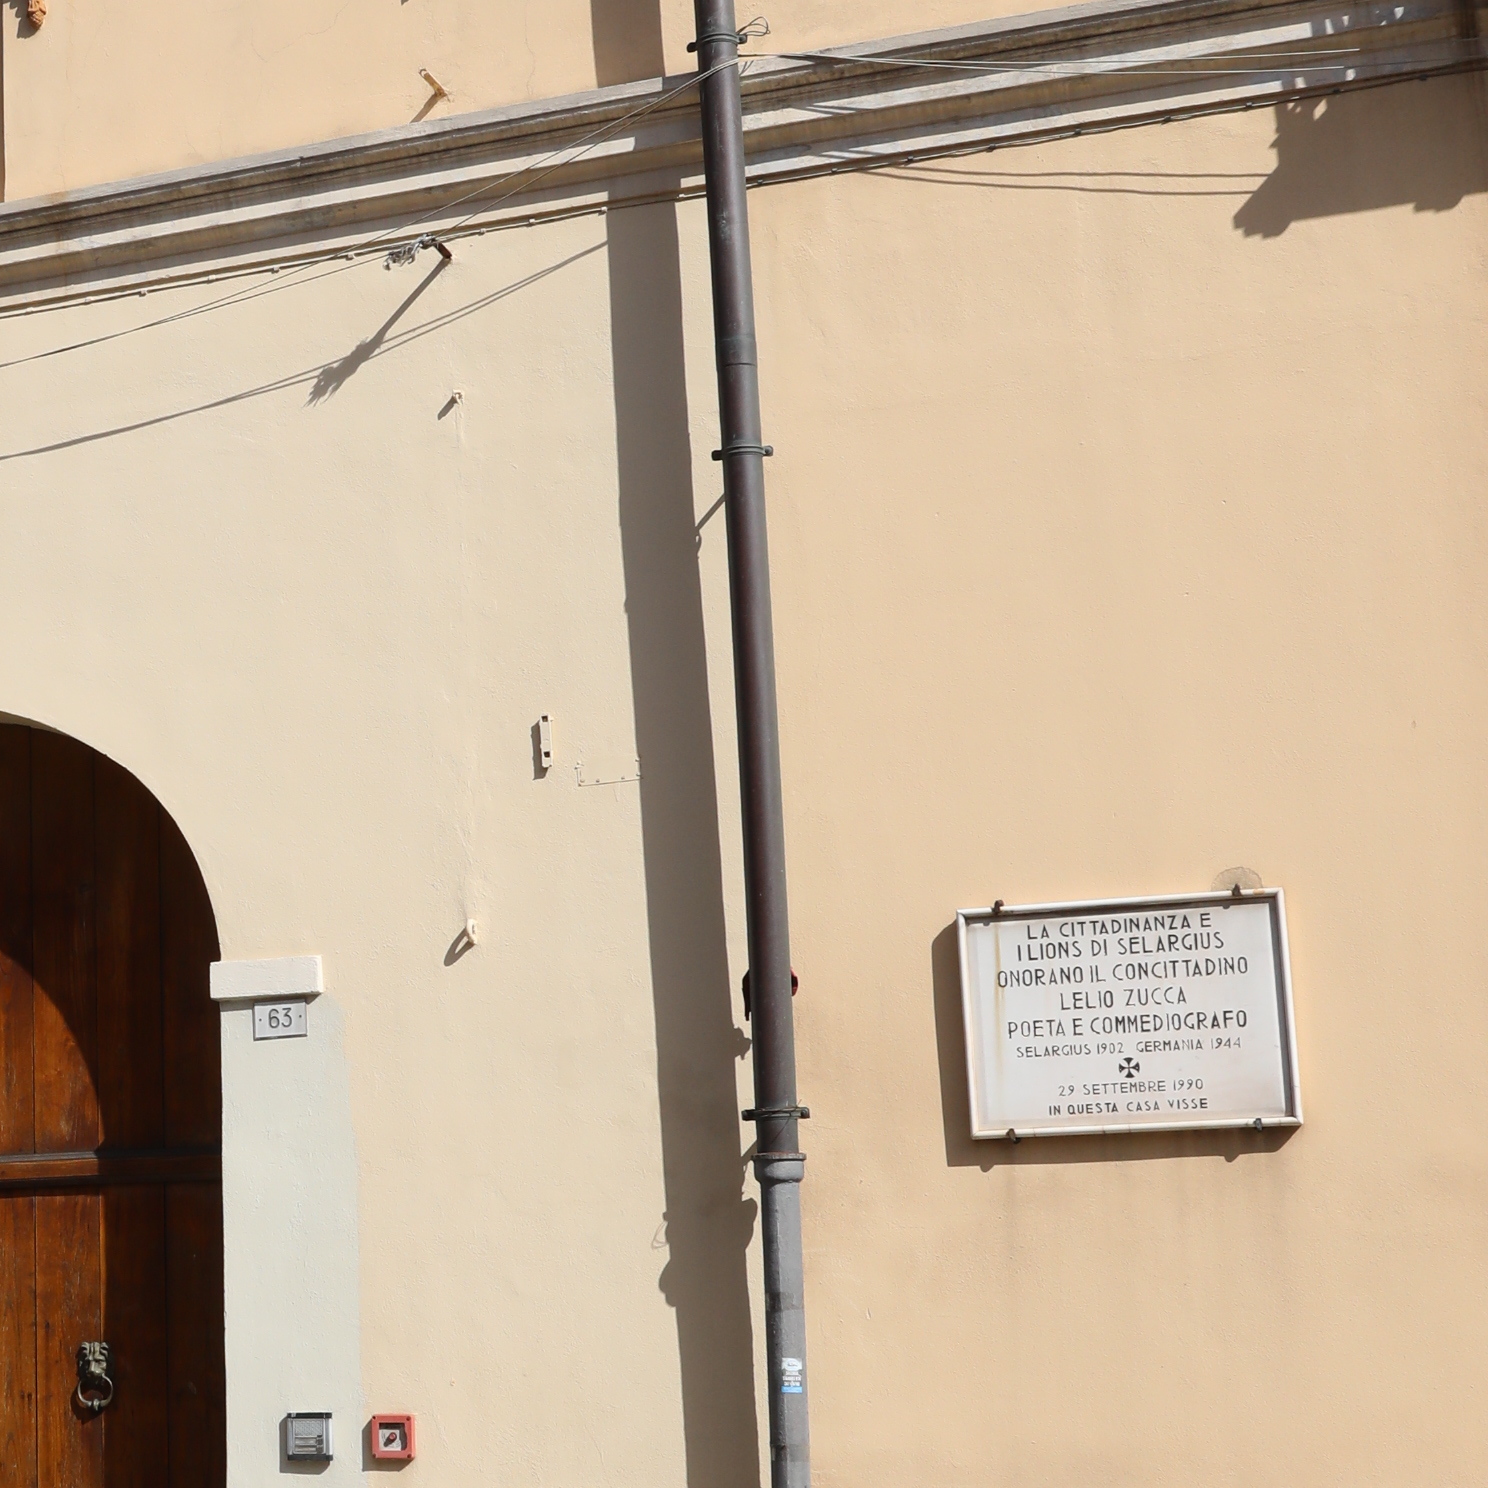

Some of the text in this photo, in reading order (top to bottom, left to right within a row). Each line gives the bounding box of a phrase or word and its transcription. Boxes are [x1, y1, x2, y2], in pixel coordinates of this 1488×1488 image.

[1027, 913, 1212, 940] LA CITTADINANZA E
[1017, 932, 1224, 961] I LIONS DI SELARGIUS
[997, 957, 1248, 988] ONORANO IL CONCITTADINO
[1060, 986, 1187, 1010] LELIO ZUCCA
[268, 1008, 292, 1028] 63
[1007, 1010, 1247, 1039] POETA E COMMEDIOGRAFO
[1016, 1037, 1241, 1058] SELARGIUS 1902 GERMANIA 1944
[1058, 1078, 1204, 1097] 29 SETTEMBRE 1990
[1049, 1098, 1208, 1116] IN QUESTA CASA VISSE
